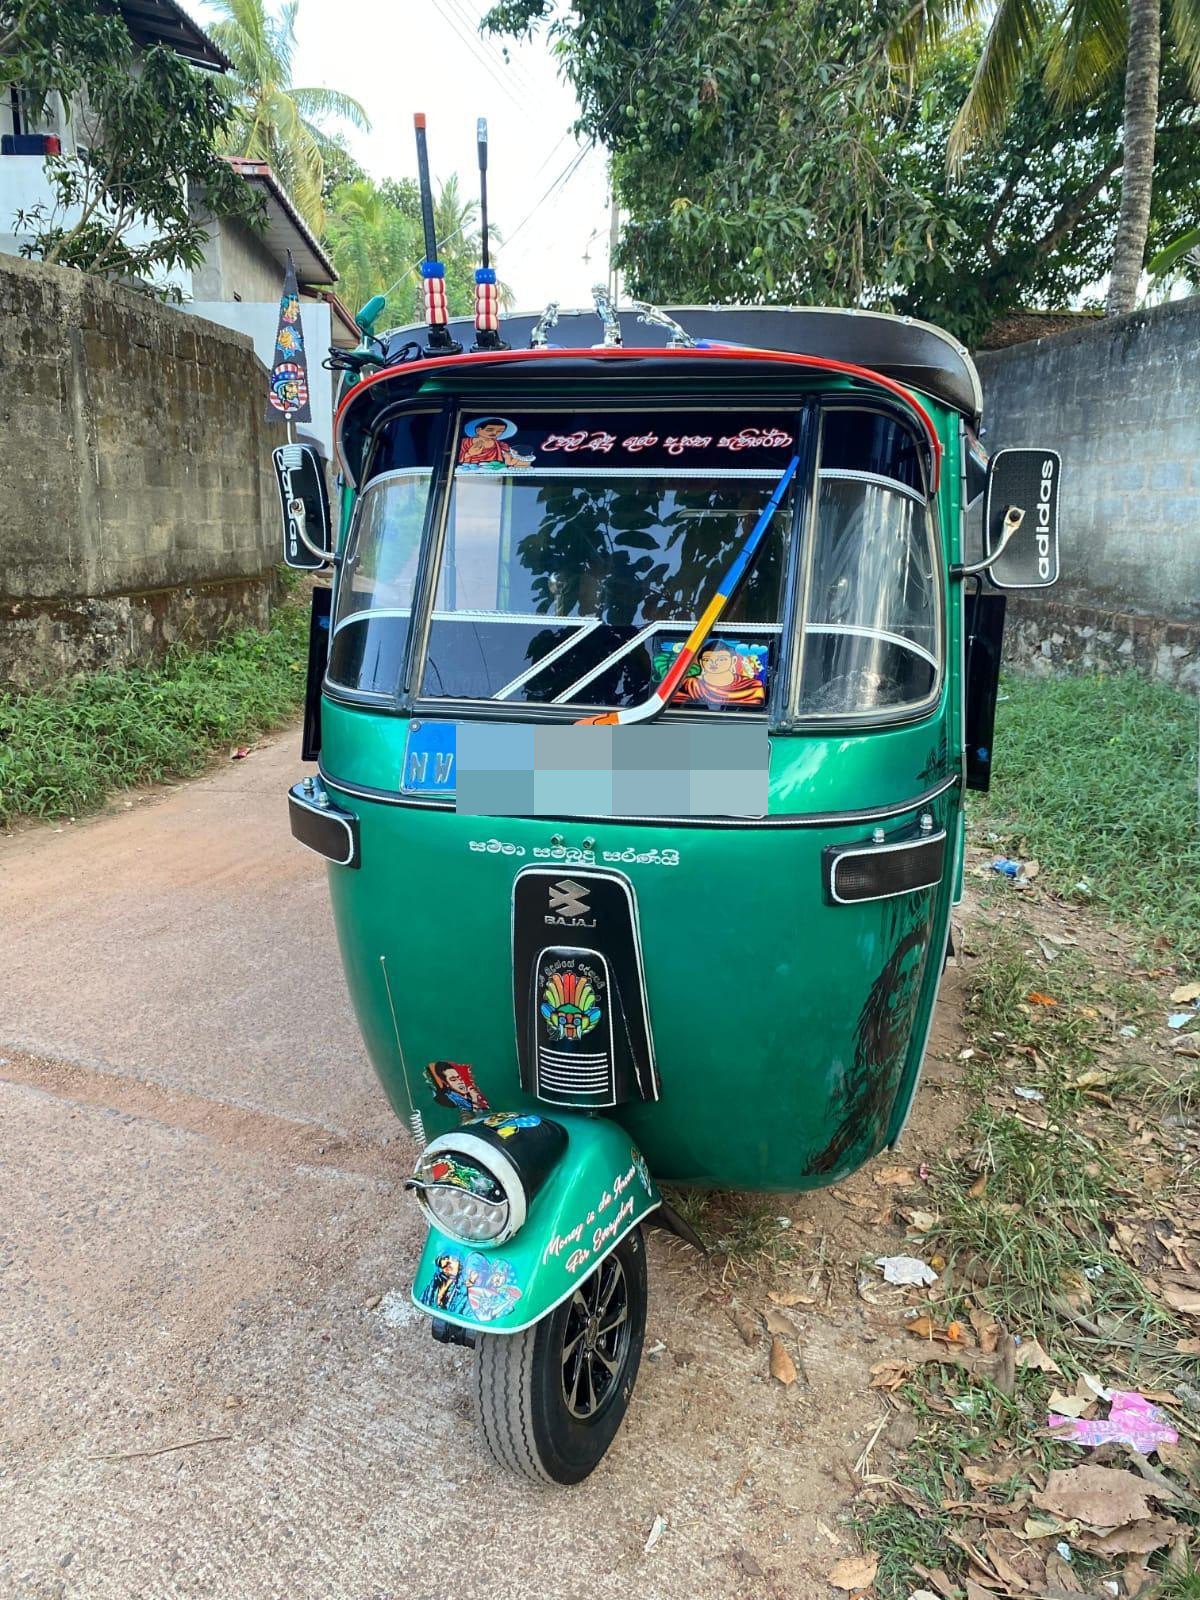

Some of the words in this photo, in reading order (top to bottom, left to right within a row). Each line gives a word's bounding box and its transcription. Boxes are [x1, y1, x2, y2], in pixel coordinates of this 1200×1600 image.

[1036, 459, 1054, 579] adidas
[468, 837, 526, 857] සම්මා
[544, 915, 597, 928] BAJAJ
[542, 1222, 584, 1265] Money
[586, 1211, 596, 1225] is
